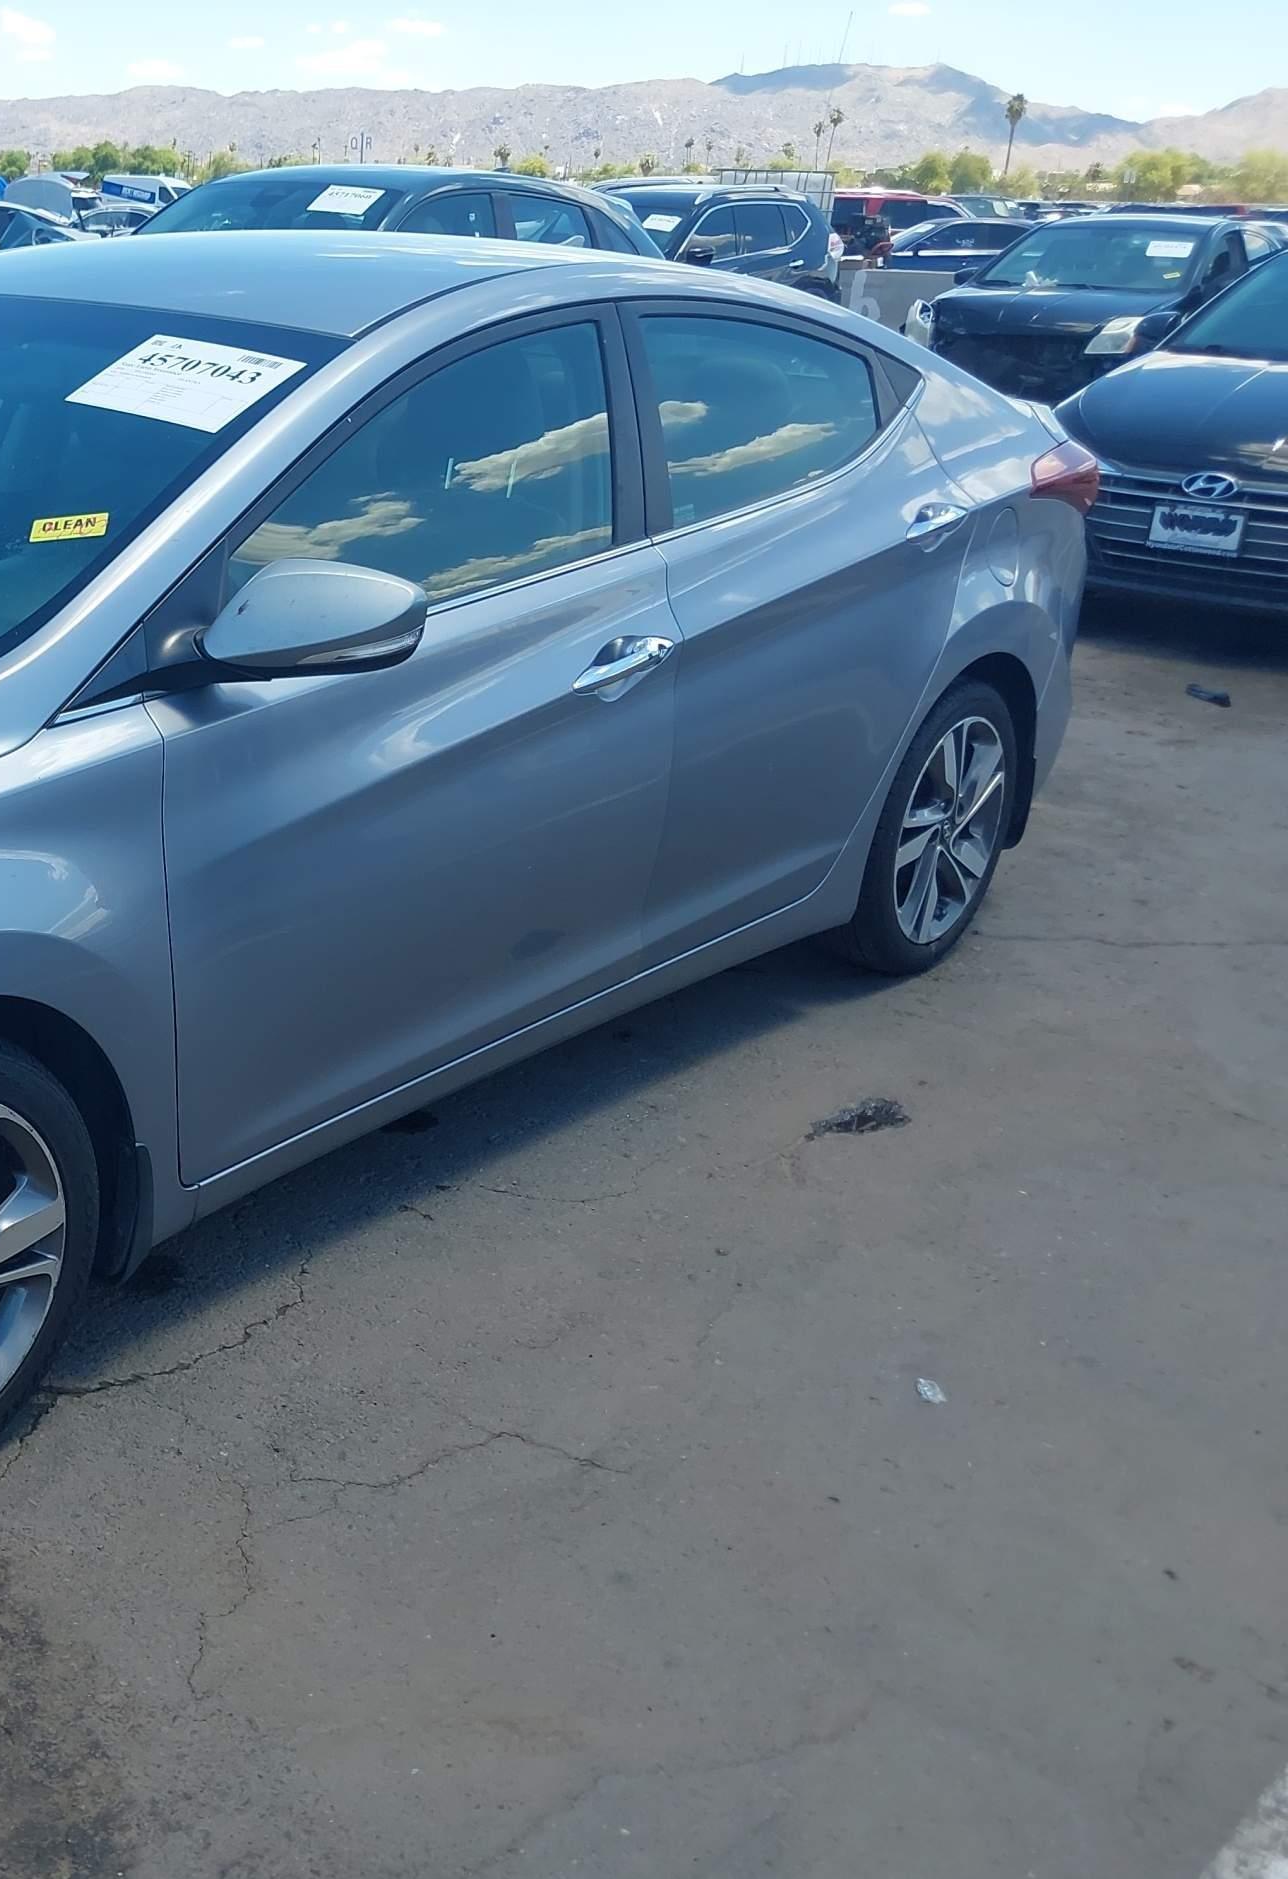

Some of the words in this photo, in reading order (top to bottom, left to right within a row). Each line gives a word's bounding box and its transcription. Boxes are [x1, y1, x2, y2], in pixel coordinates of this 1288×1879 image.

[350, 136, 358, 150] Q
[365, 136, 372, 150] R
[138, 352, 263, 385] 45707043
[42, 517, 97, 532] CLEAN
